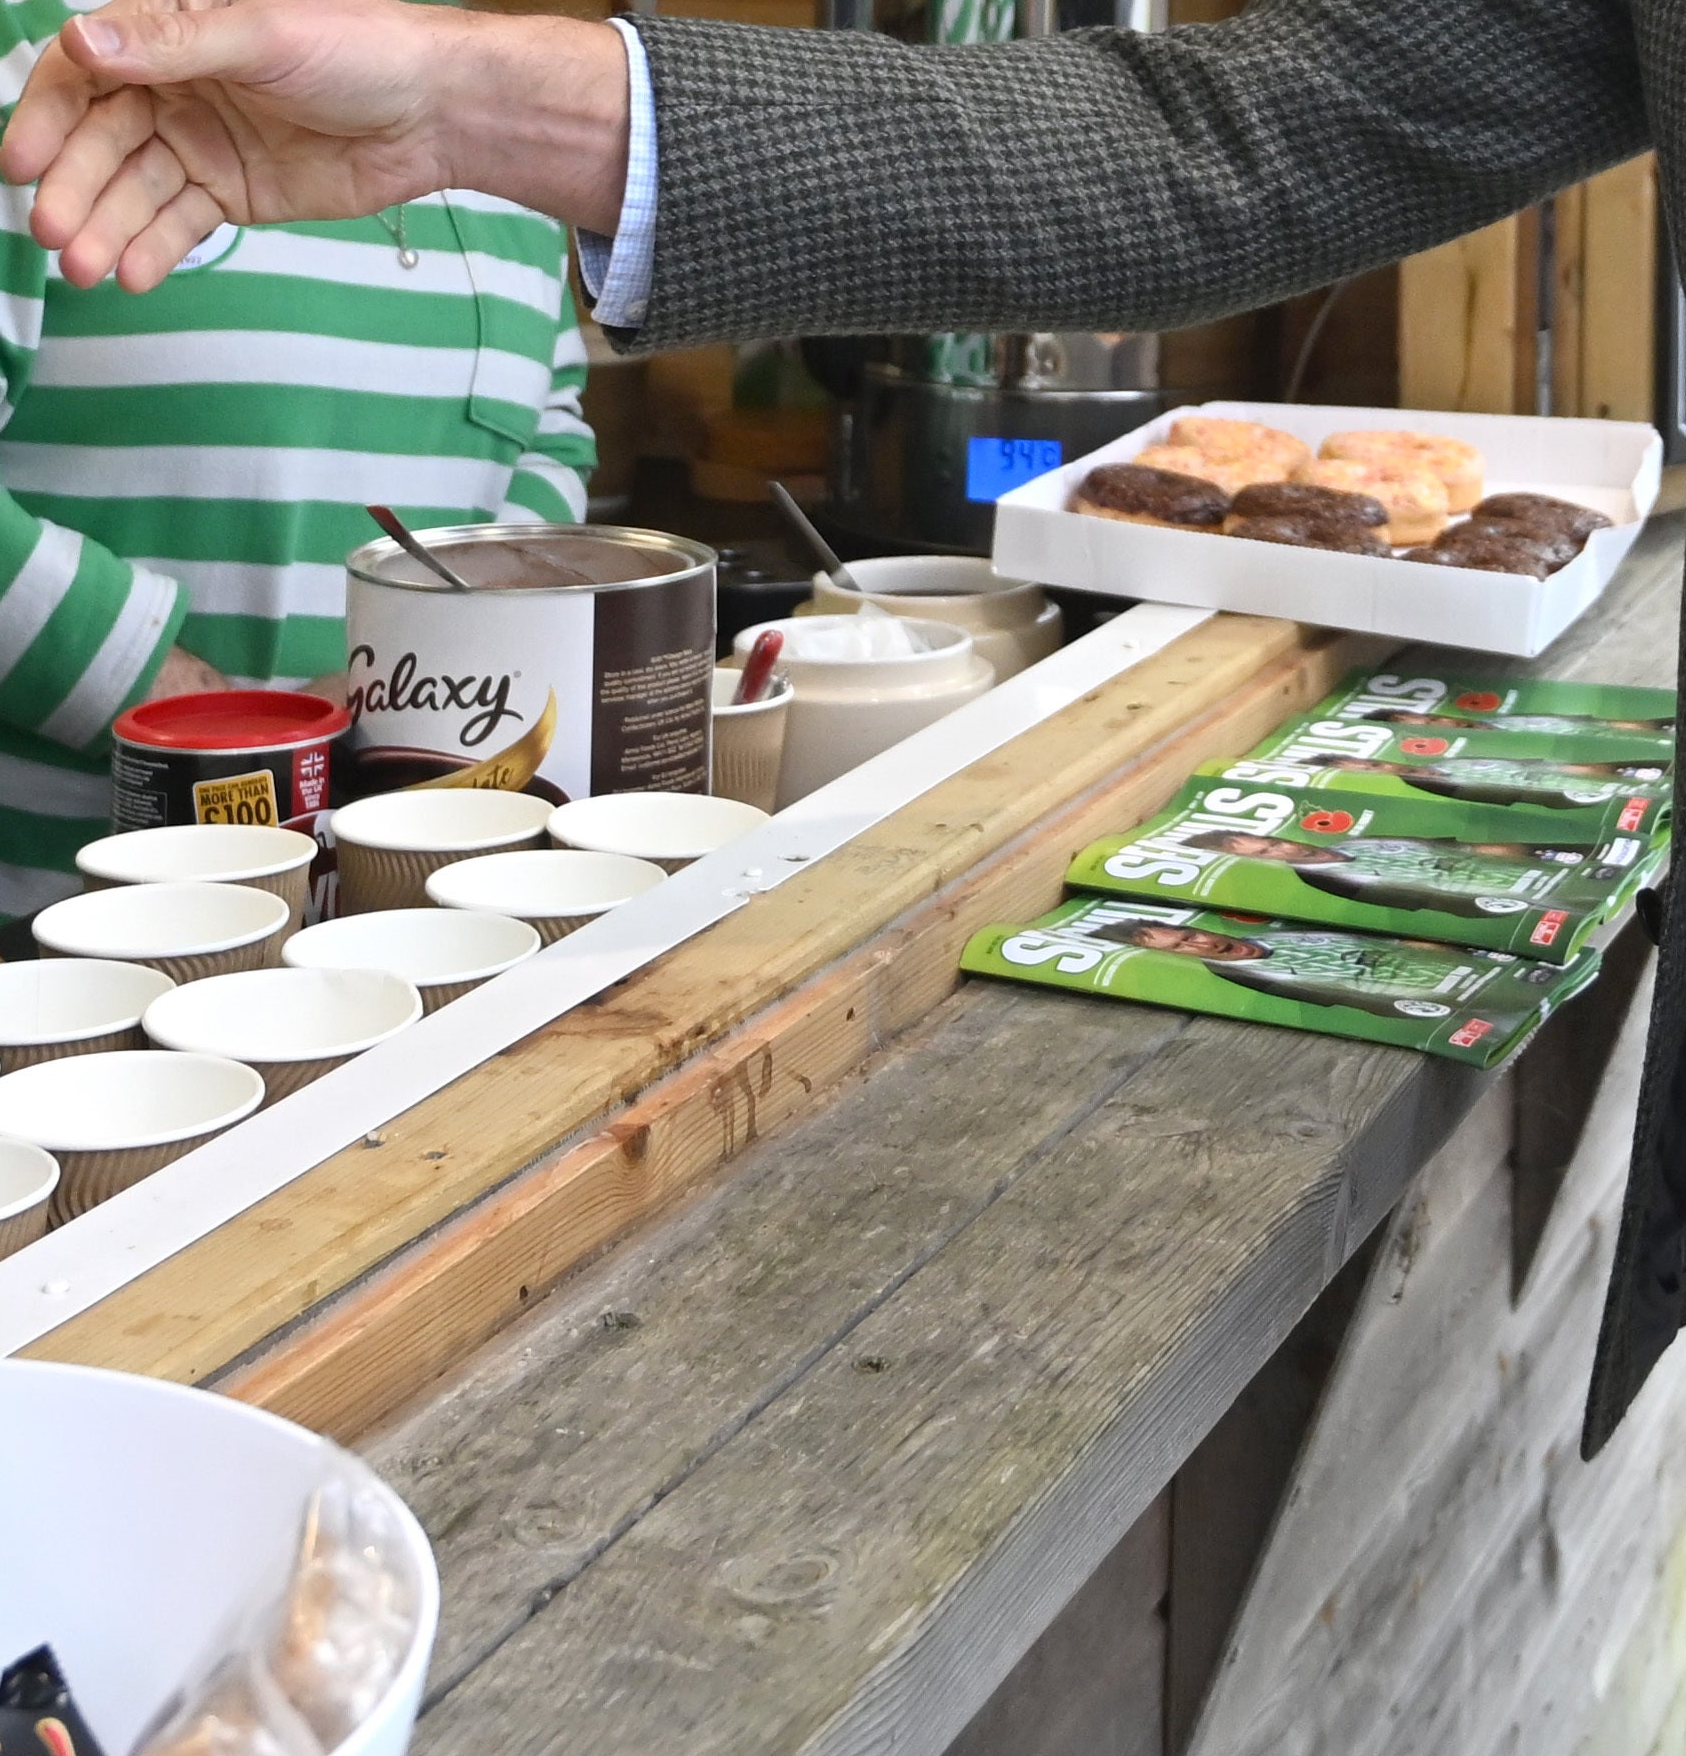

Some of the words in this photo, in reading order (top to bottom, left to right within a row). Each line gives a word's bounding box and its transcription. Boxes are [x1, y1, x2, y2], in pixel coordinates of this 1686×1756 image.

[347, 643, 524, 748] Galaxy
[200, 790, 234, 806] MORE
[238, 783, 269, 800] THAN
[204, 796, 272, 825] £100
